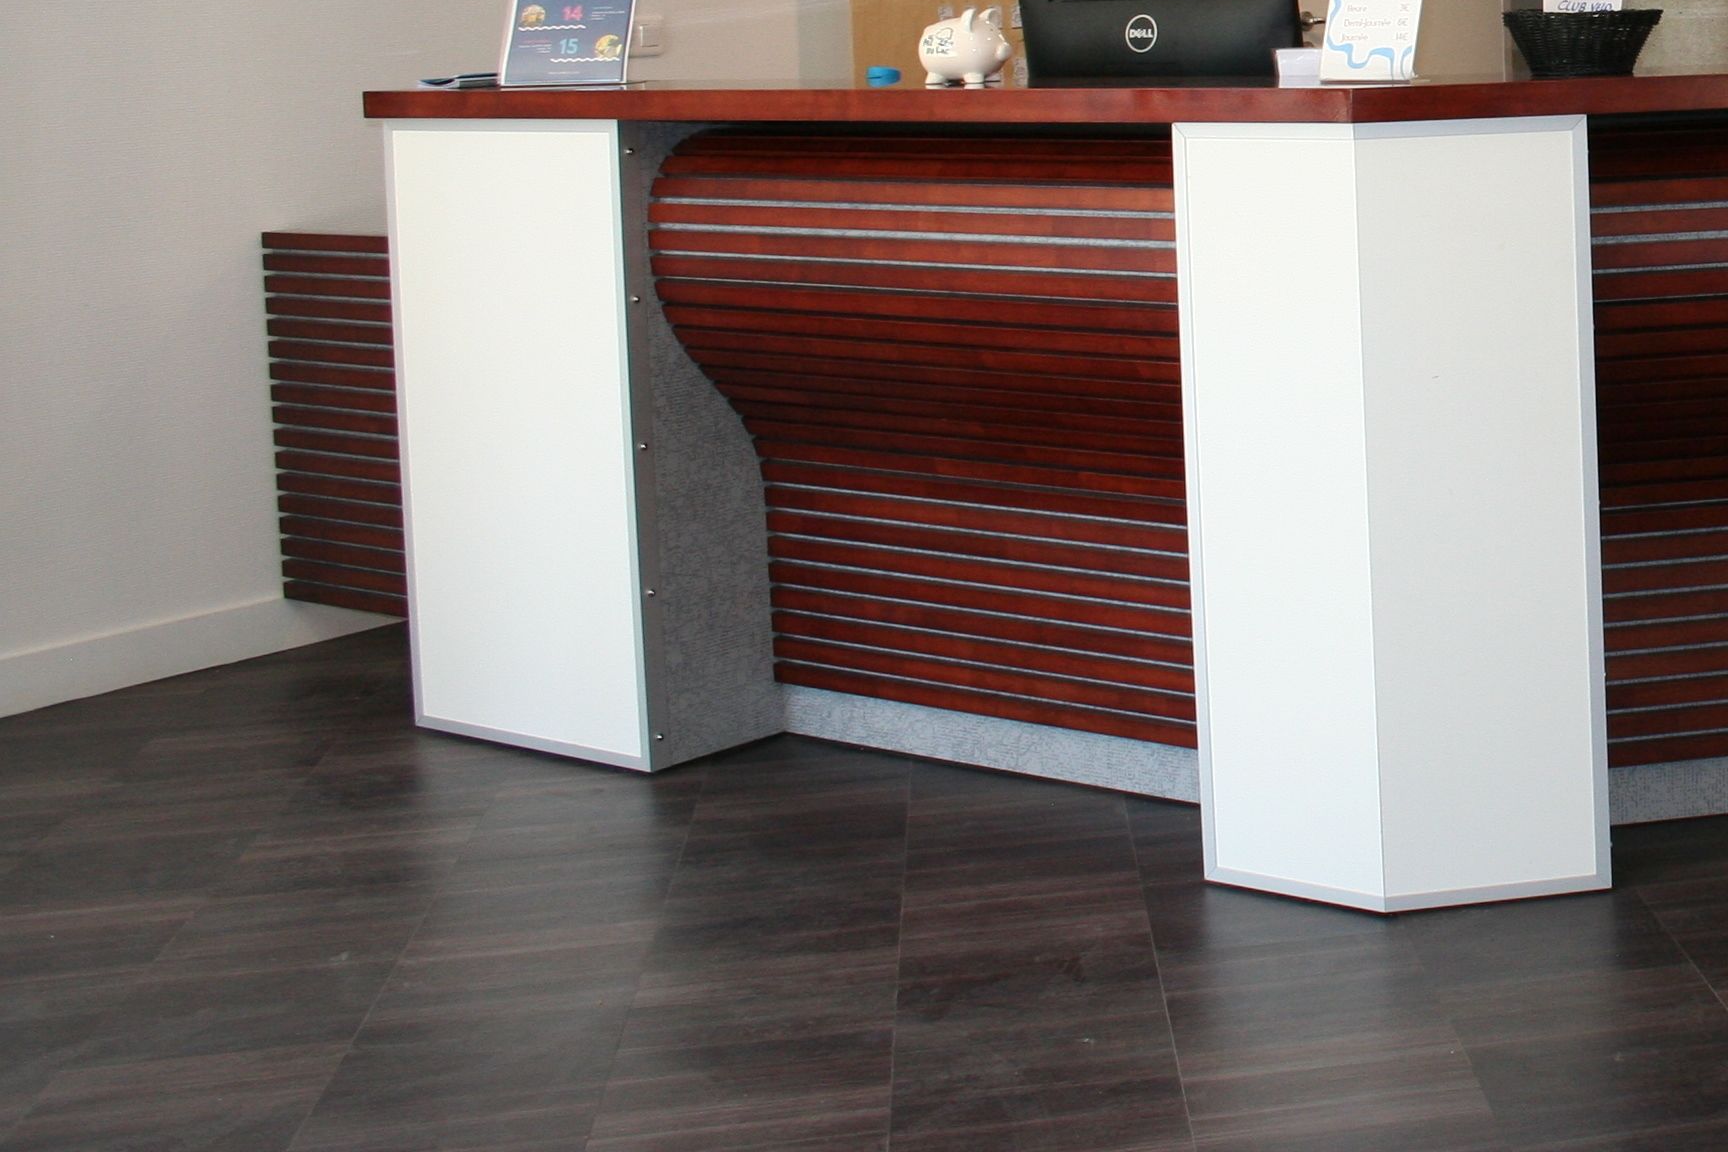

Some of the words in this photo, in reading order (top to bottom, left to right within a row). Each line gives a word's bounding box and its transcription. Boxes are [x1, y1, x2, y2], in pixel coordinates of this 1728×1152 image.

[562, 5, 584, 21] 14
[1558, 0, 1587, 12] CLUB
[1129, 28, 1153, 38] DELL
[559, 38, 579, 54] 15
